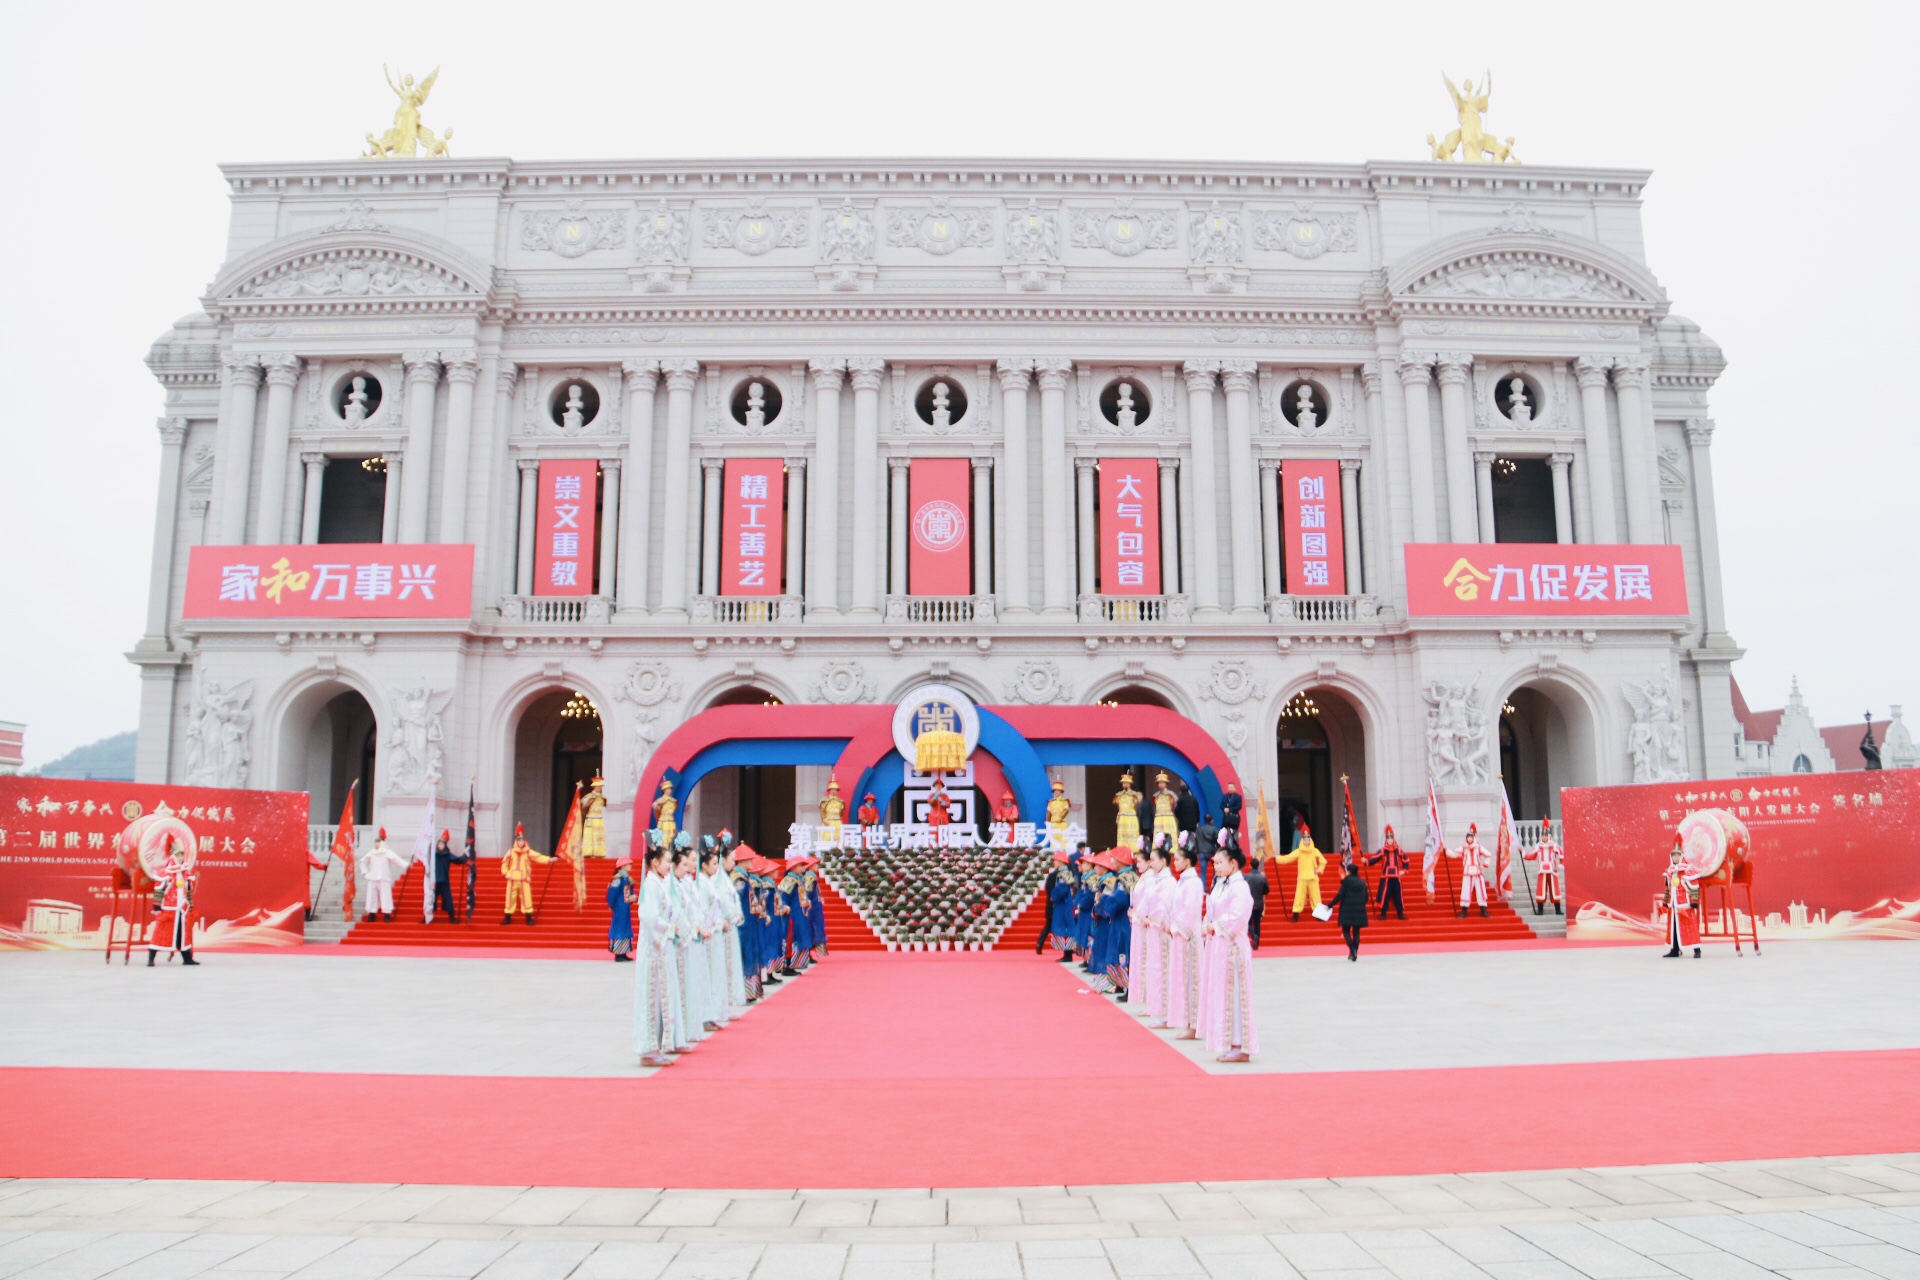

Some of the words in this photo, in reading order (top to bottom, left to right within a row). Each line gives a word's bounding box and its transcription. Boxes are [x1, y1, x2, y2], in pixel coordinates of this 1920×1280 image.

[567, 224, 580, 237] N
[749, 223, 762, 235] N
[934, 223, 947, 235] N
[1118, 223, 1131, 236] N
[1300, 225, 1313, 239] N
[551, 475, 581, 586] 崇文重教
[738, 474, 768, 586] 精工善艺
[1116, 474, 1144, 585] 大气包容
[1298, 475, 1329, 586] 创新图强
[219, 557, 436, 604] 家和万事兴
[1443, 557, 1653, 601] 合力促发展
[17, 796, 113, 817] 家和万事兴
[1832, 791, 1883, 809] 签名墙
[154, 800, 235, 822] 合力促发展
[788, 822, 1088, 850] 第二届世界东阳人发展大会
[31, 856, 63, 864] WORLD
[63, 857, 108, 865] DONGYANG
